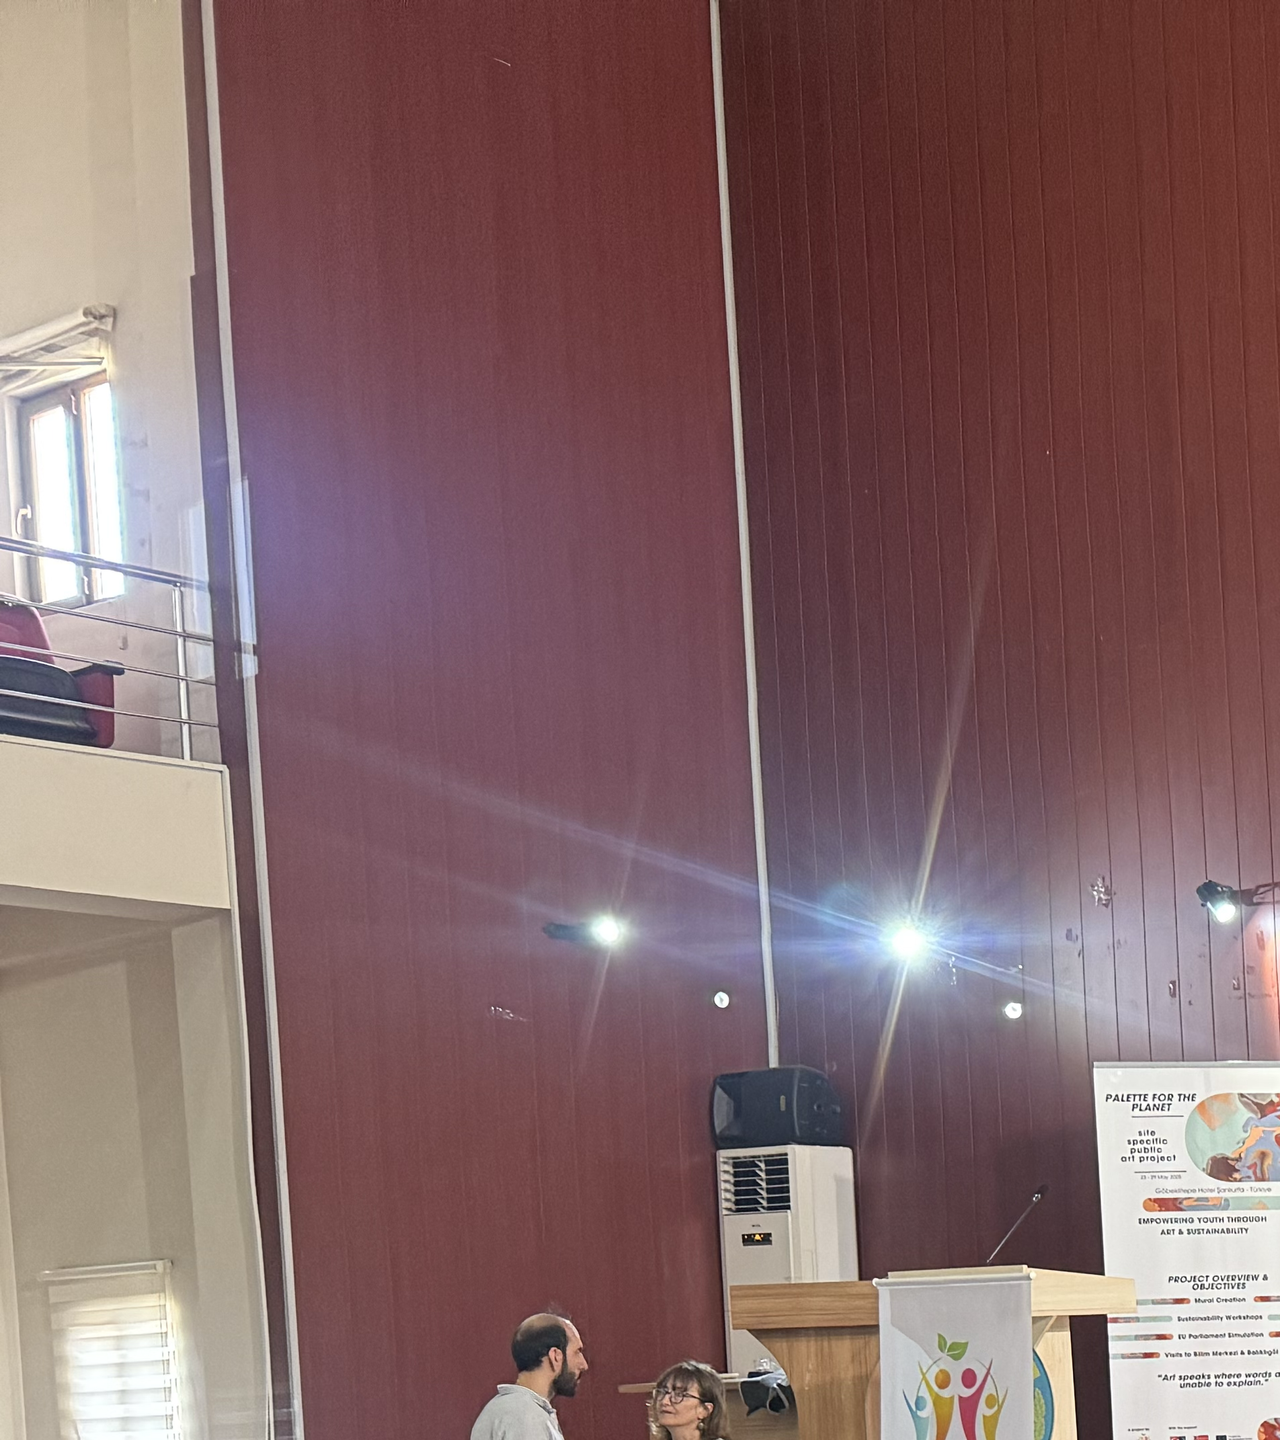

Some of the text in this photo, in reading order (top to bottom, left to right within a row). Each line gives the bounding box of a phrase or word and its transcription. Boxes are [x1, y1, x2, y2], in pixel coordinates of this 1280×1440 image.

[1105, 1093, 1197, 1102] PALETTE FOR THE
[1131, 1103, 1172, 1112] PLANET
[1127, 1137, 1168, 1146] specific
[1130, 1146, 1162, 1154] public
[1139, 1155, 1176, 1163] project
[1138, 1217, 1195, 1225] EMPOWERING
[1168, 1275, 1210, 1283] PROJECT
[1212, 1274, 1260, 1282] OVERVIEW
[1192, 1282, 1247, 1290] OBJECTIVES
[1178, 1373, 1211, 1381] speaks
[1214, 1371, 1242, 1380] where
[1244, 1371, 1272, 1379] words
[1179, 1381, 1212, 1389] unable
